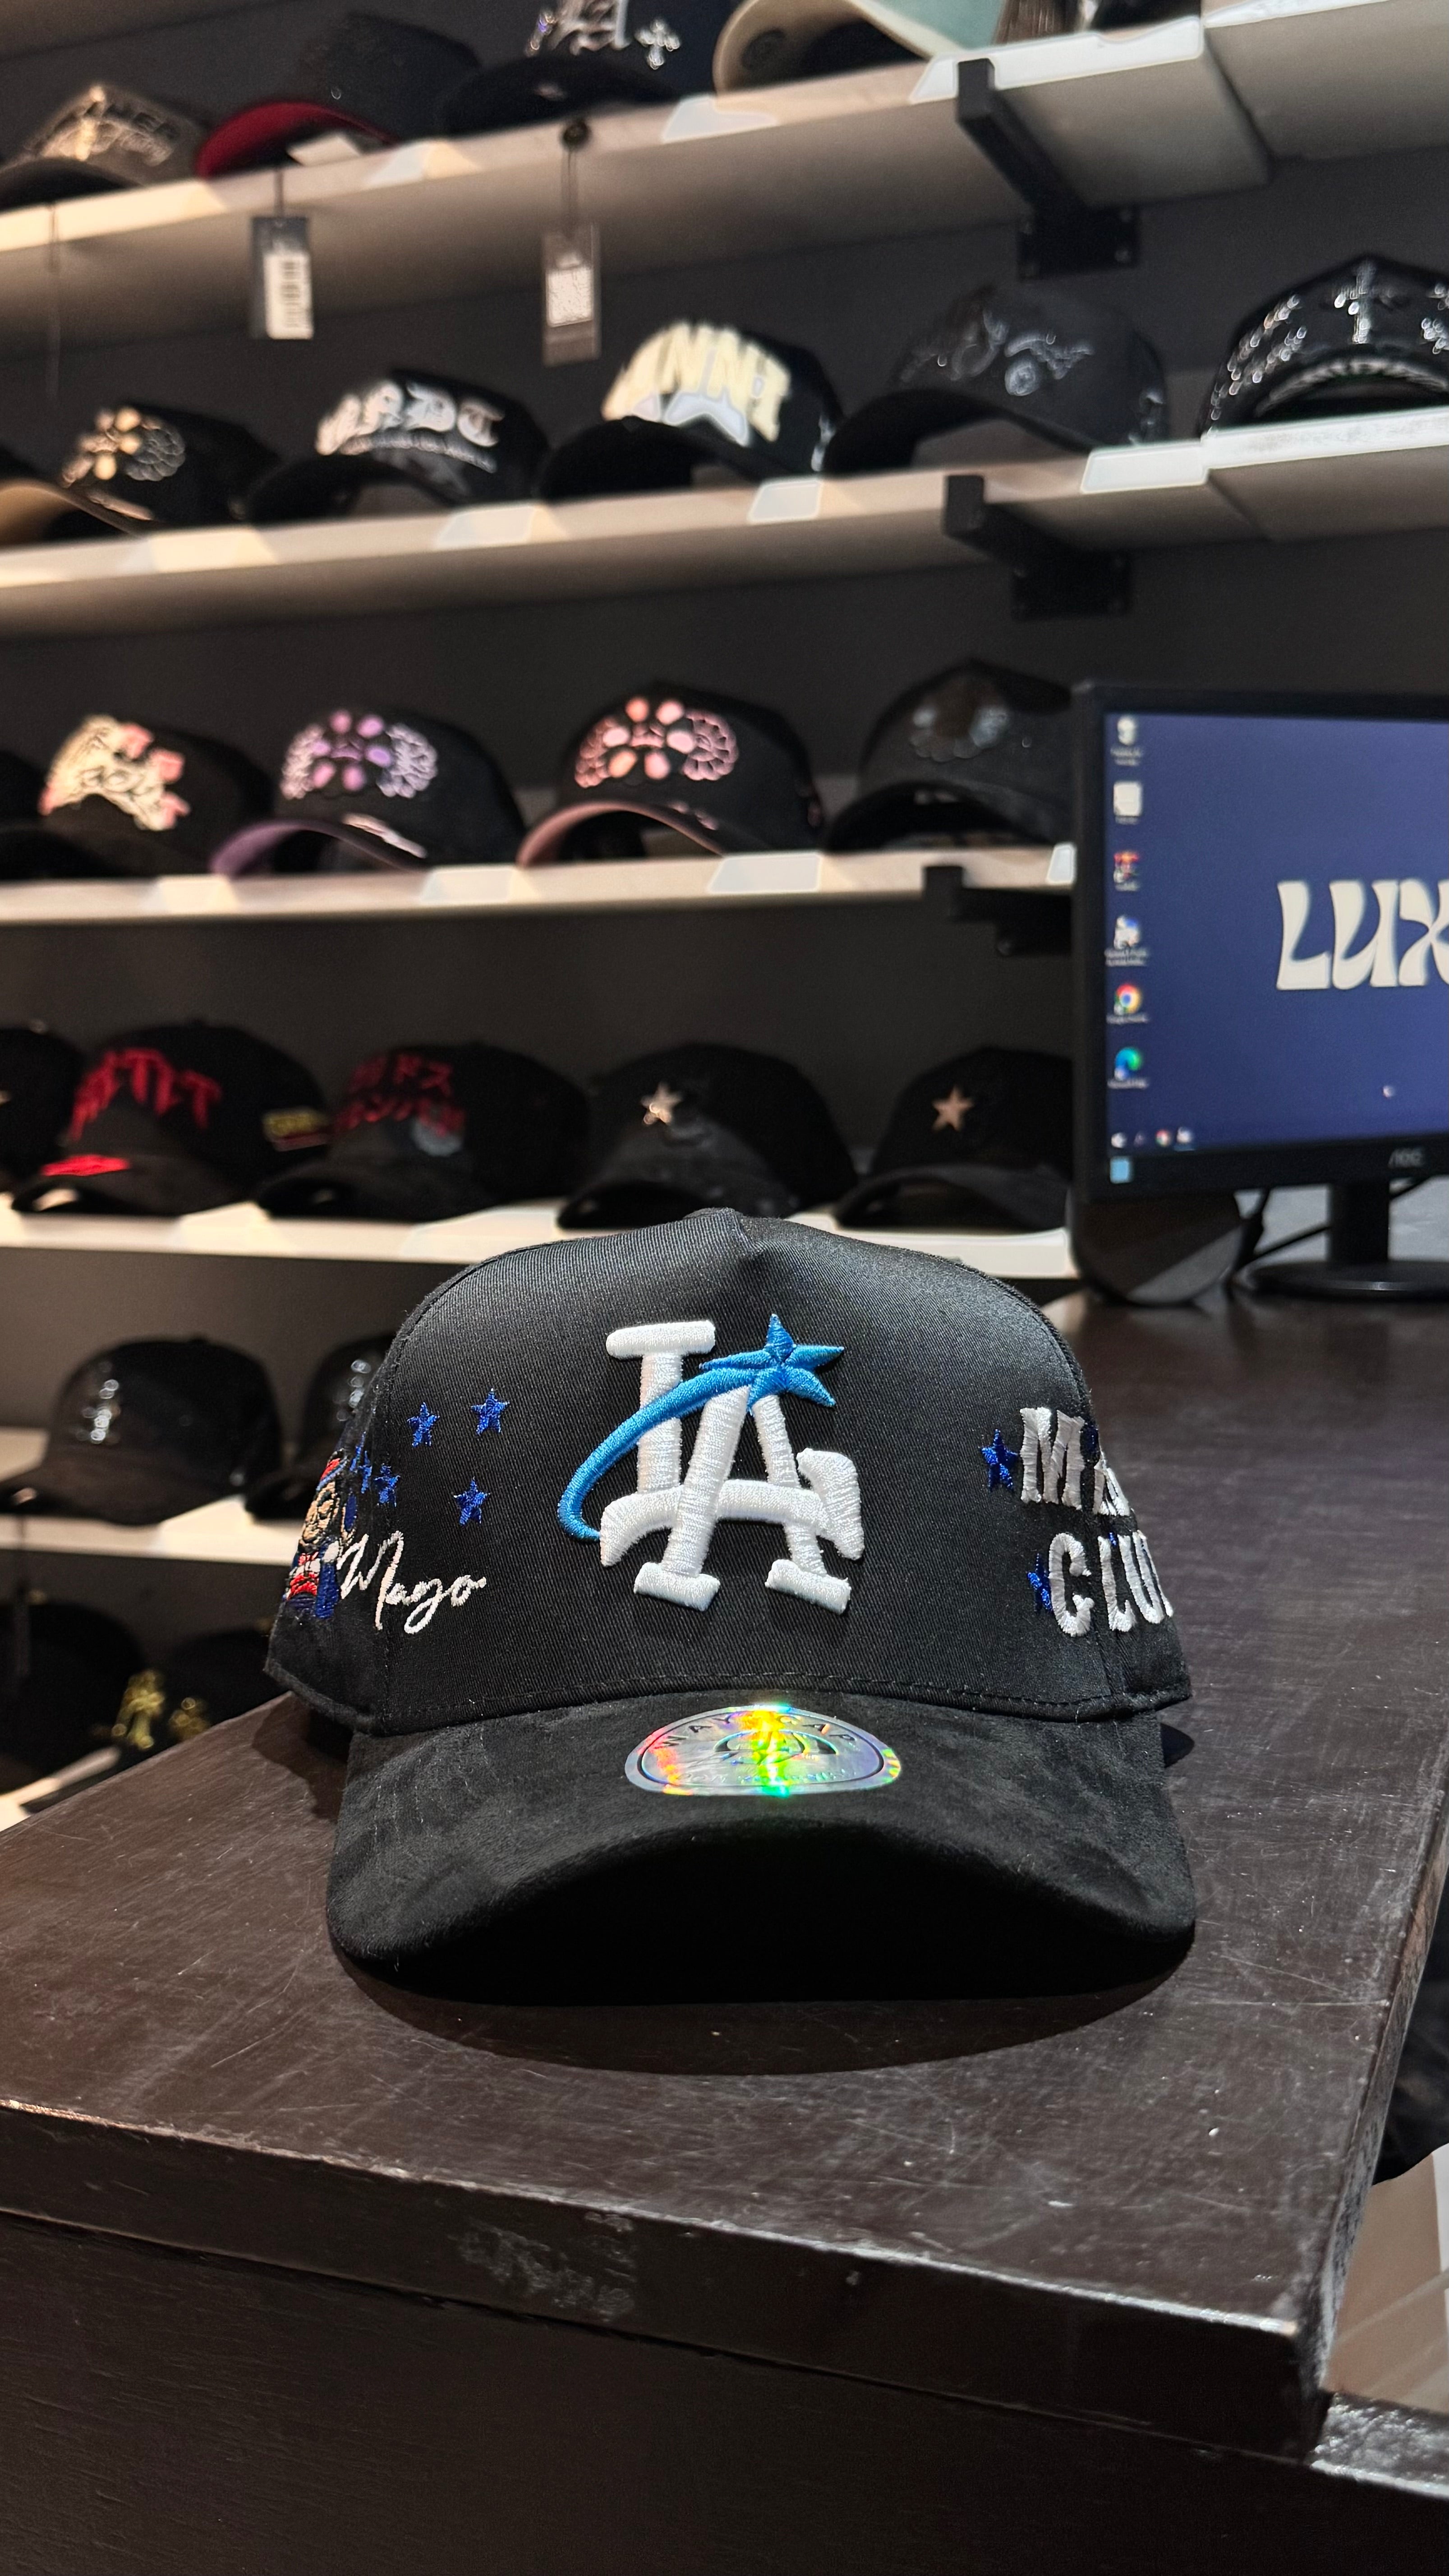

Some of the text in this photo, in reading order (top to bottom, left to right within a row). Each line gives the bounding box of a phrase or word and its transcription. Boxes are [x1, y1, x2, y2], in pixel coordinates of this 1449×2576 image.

[599, 1320, 865, 1615] LA
[336, 1530, 487, 1634] Mago
[1048, 1529, 1173, 1637] CLU
